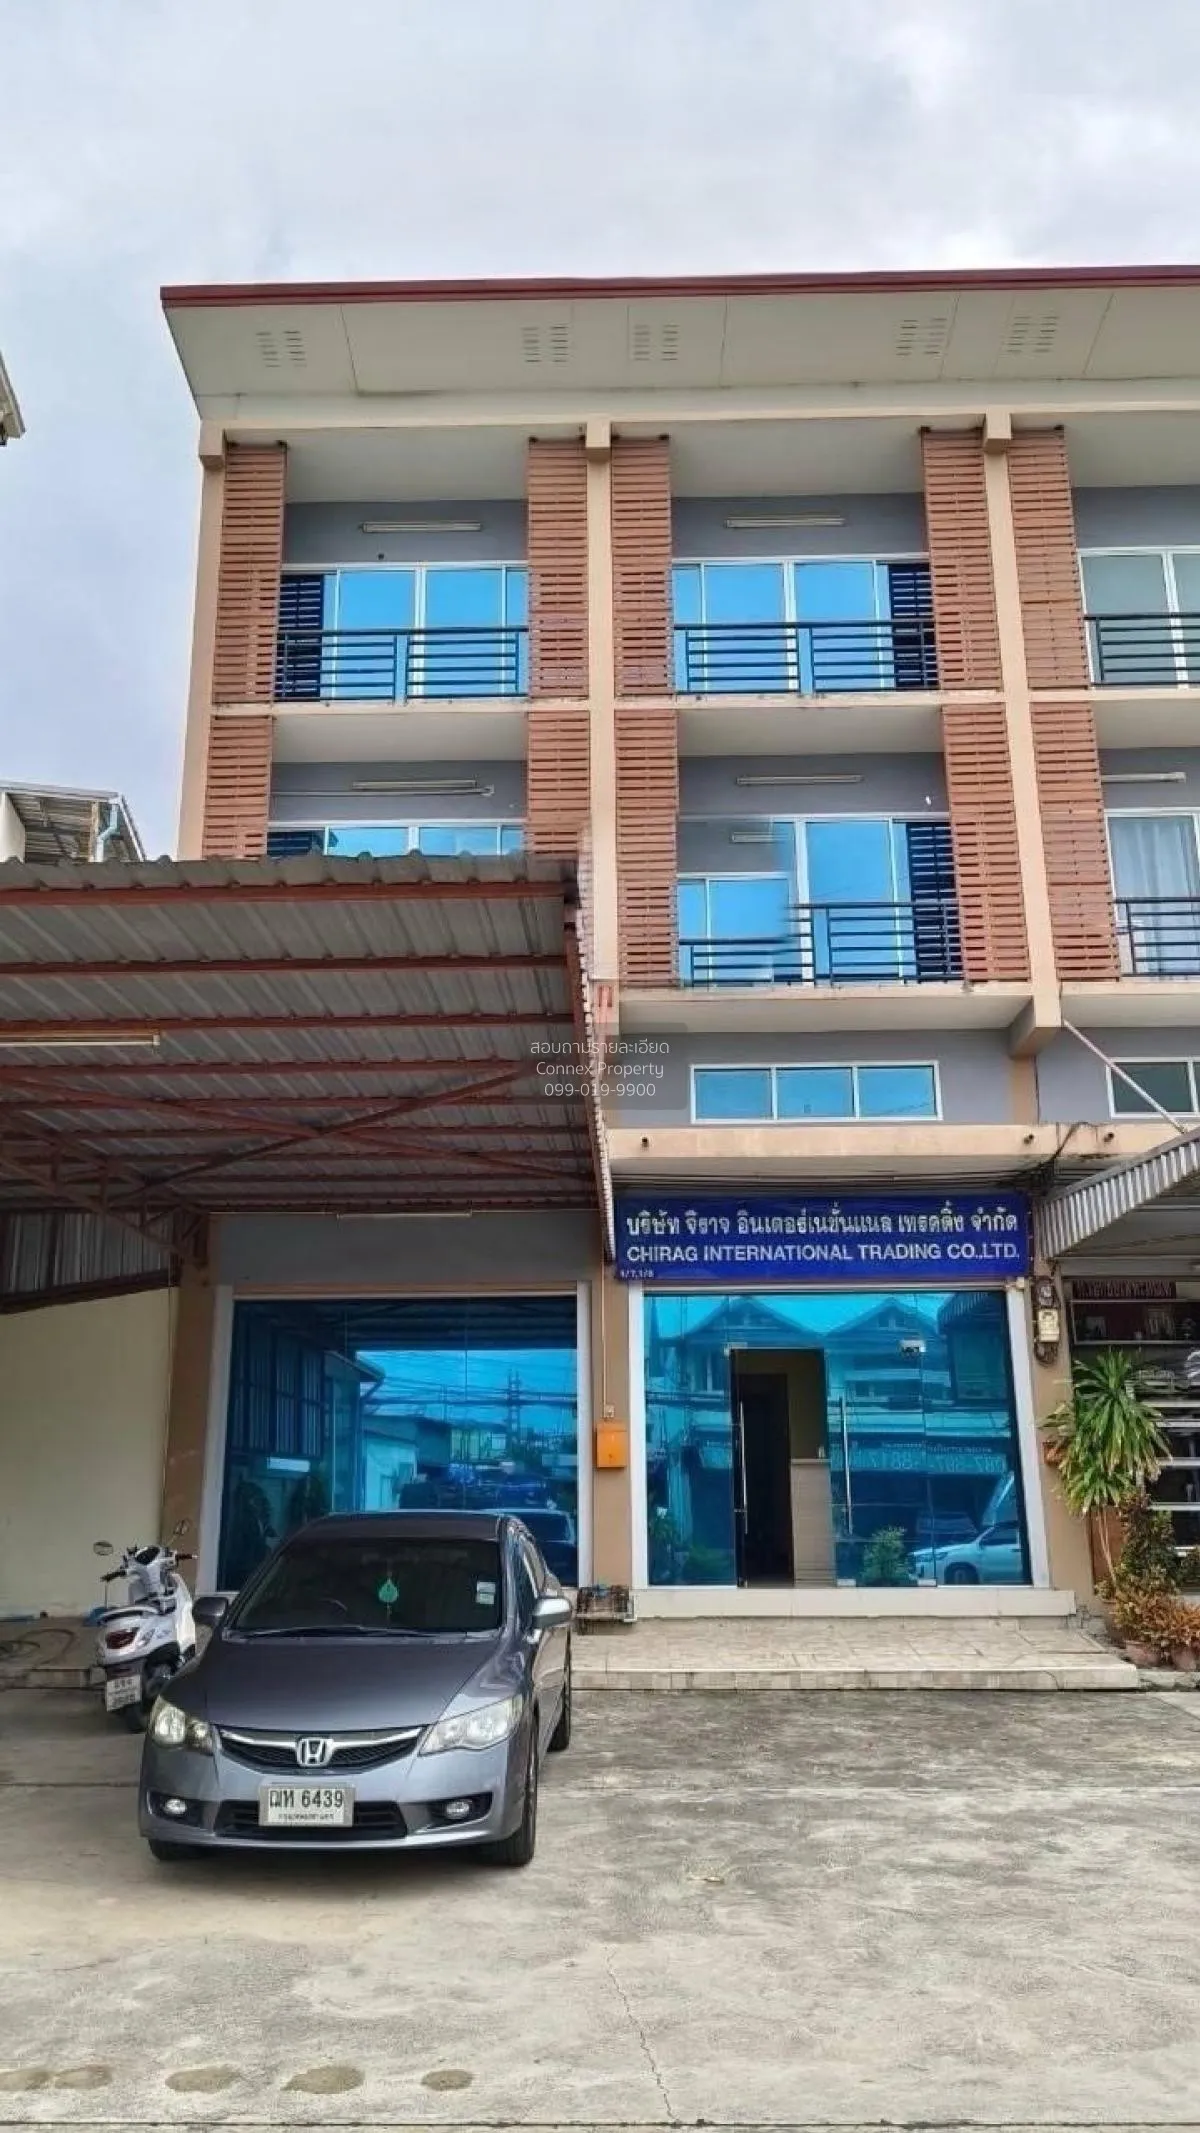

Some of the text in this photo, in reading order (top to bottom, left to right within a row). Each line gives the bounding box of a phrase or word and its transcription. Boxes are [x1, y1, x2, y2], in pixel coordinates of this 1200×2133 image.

[626, 1209, 680, 1236] บริษัท
[970, 1206, 1018, 1233] จำกัด
[626, 1246, 698, 1262] CHIRAG
[703, 1244, 854, 1261] INTERNATIONAL
[857, 1243, 942, 1261] TRADING
[301, 1790, 343, 1808] 6439
